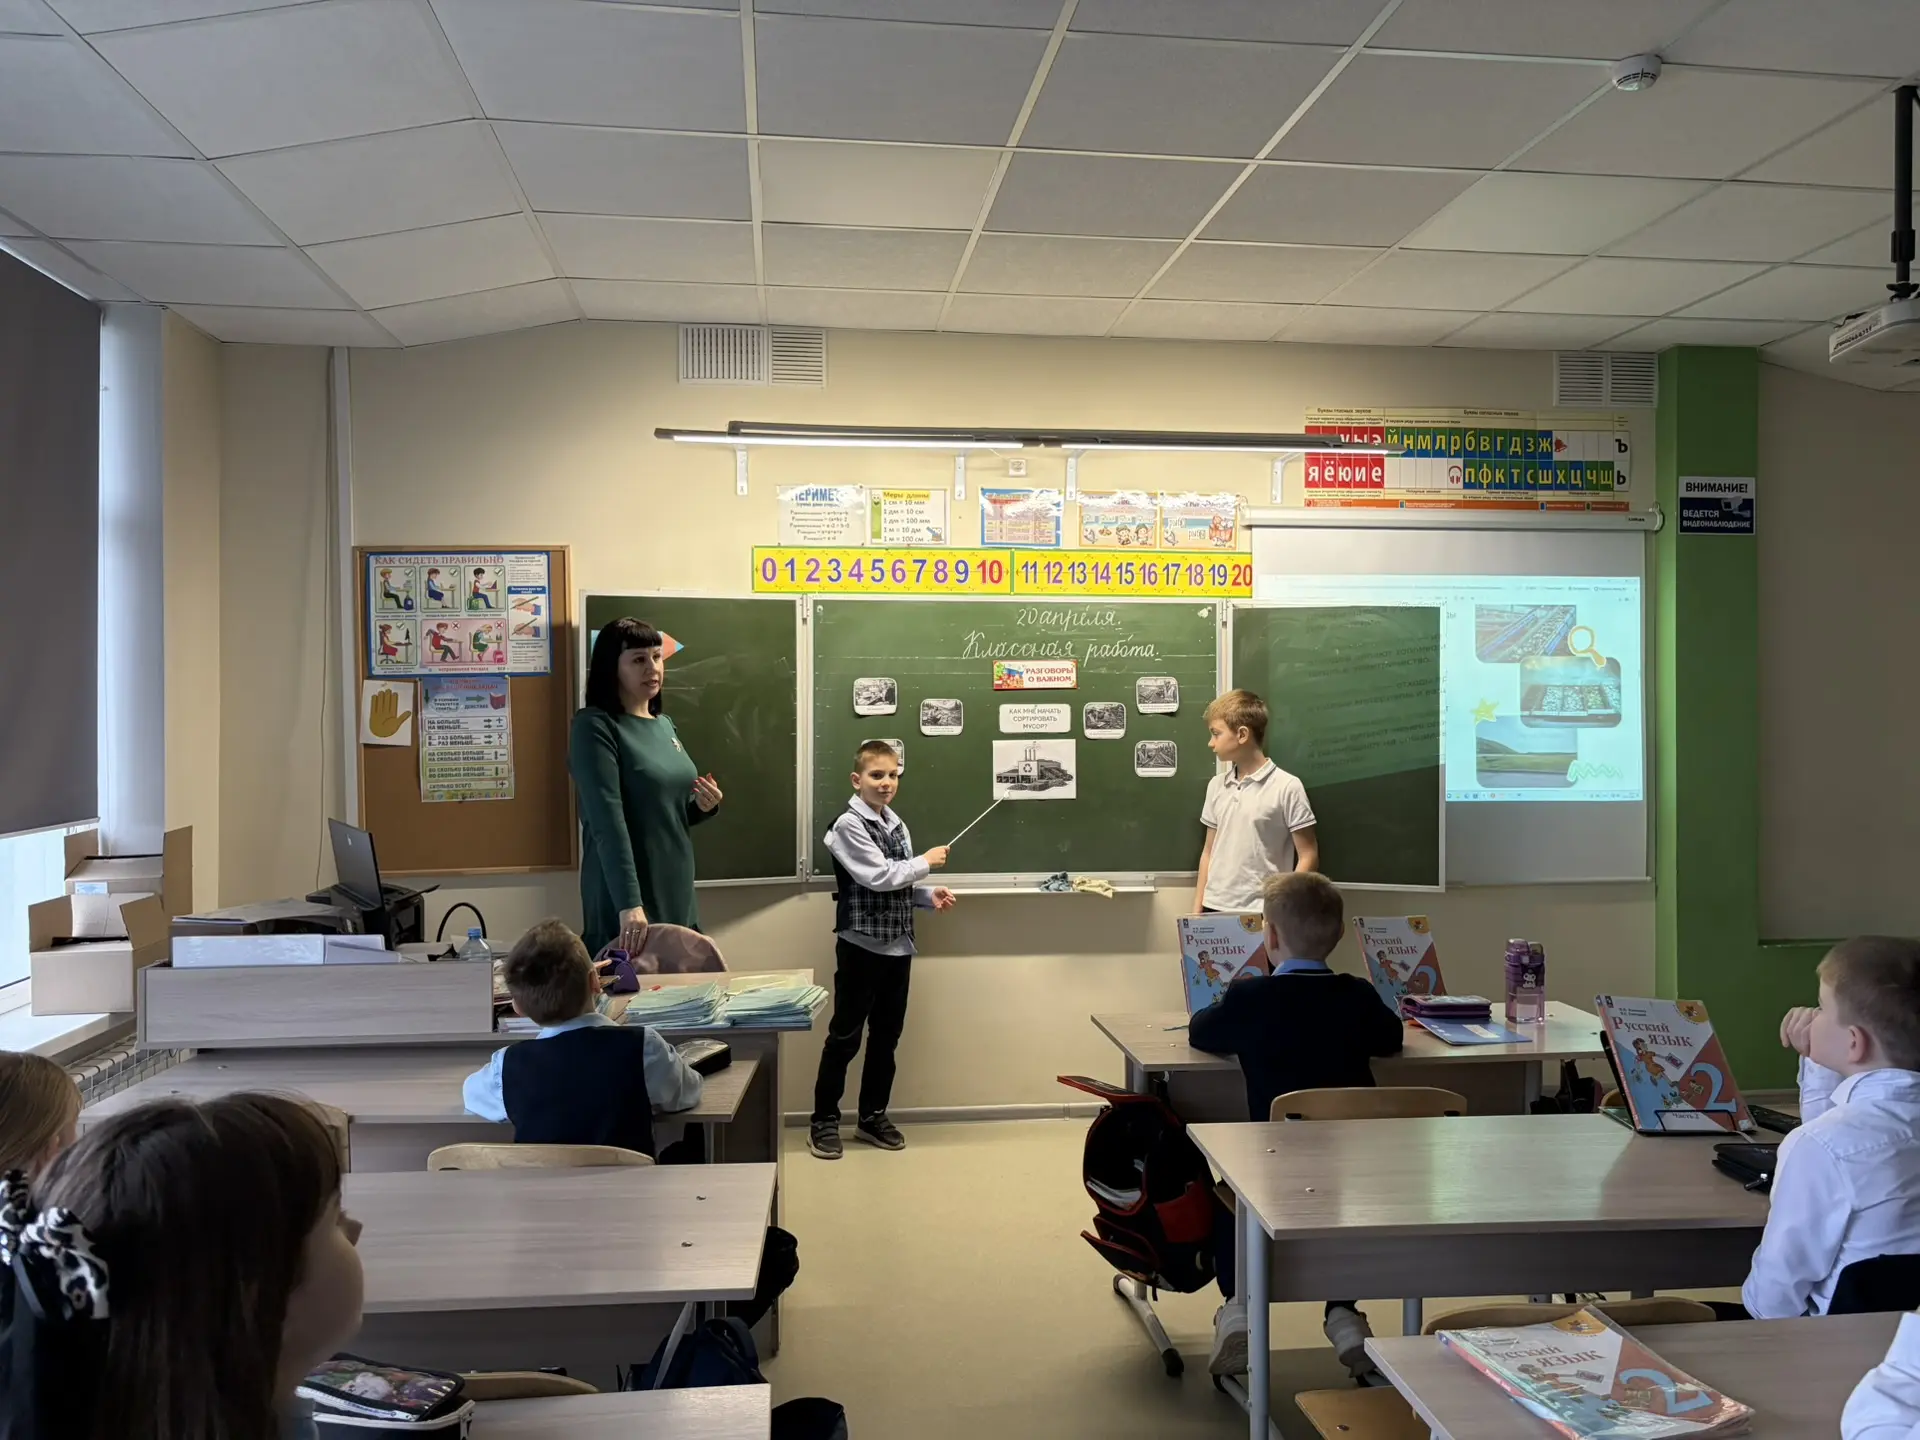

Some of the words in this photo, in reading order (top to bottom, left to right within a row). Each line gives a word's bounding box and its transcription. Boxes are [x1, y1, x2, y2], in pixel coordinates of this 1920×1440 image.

[1685, 482, 1748, 493] ВНИМАНИЕ!
[1683, 510, 1720, 518] ВЕДЕТСЯ
[1682, 520, 1751, 528] ВИДЕОНАБЛЮДЕНИЕ
[375, 556, 396, 565] КАК
[399, 556, 439, 565] СИДЕТЬ
[441, 556, 504, 565] ПРАВИЛЬНО
[762, 557, 777, 582] 0
[785, 557, 796, 582] 1
[805, 558, 820, 582] 2
[827, 558, 842, 583] 3
[848, 558, 864, 583] 4
[871, 559, 885, 583] 5
[891, 559, 907, 583] 6
[912, 559, 927, 583] 7
[933, 559, 949, 584] 8
[954, 559, 969, 584] 9
[976, 560, 1002, 584] 10
[1021, 560, 1038, 584] 11
[1043, 561, 1062, 584] 12
[1068, 561, 1087, 585] 13
[1091, 562, 1111, 585] 14
[1115, 562, 1135, 585] 15
[1139, 563, 1158, 586] 16
[1162, 563, 1181, 586] 17
[1185, 563, 1204, 586] 18
[1208, 564, 1227, 586] 19
[1231, 564, 1252, 587] 20
[963, 630, 1075, 659] Классная
[1186, 934, 1230, 947] Русский
[1363, 933, 1403, 947] Русский
[1612, 1016, 1670, 1033] Русский
[1691, 1062, 1737, 1113] 2
[1672, 1112, 1694, 1120] Часть
[1619, 1368, 1714, 1415] 2
